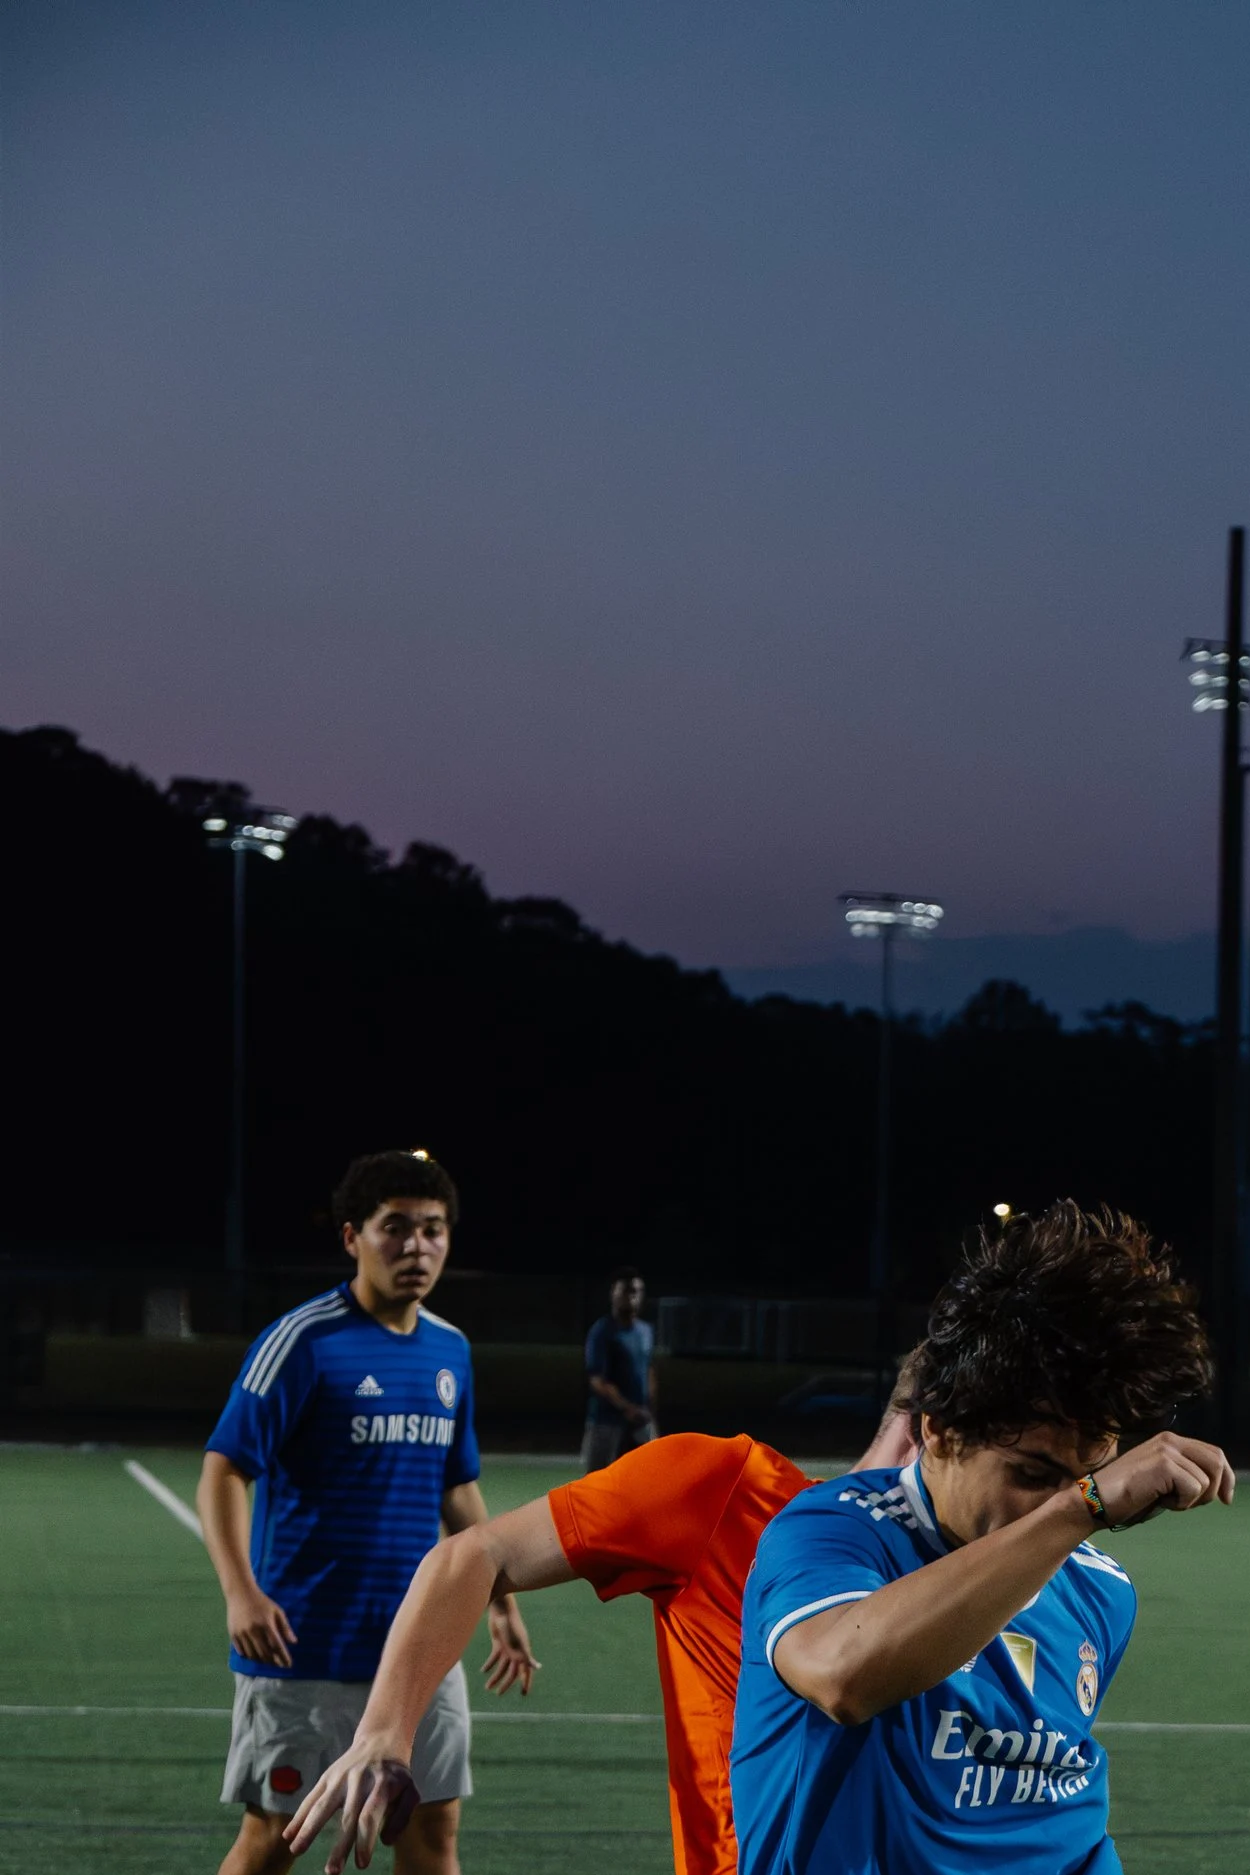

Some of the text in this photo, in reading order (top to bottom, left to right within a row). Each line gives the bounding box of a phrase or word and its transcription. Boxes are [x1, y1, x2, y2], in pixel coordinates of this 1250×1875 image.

[350, 1414, 456, 1447] SAMSUN
[931, 1709, 1099, 1767] Emira
[955, 1764, 1005, 1809] FLY
